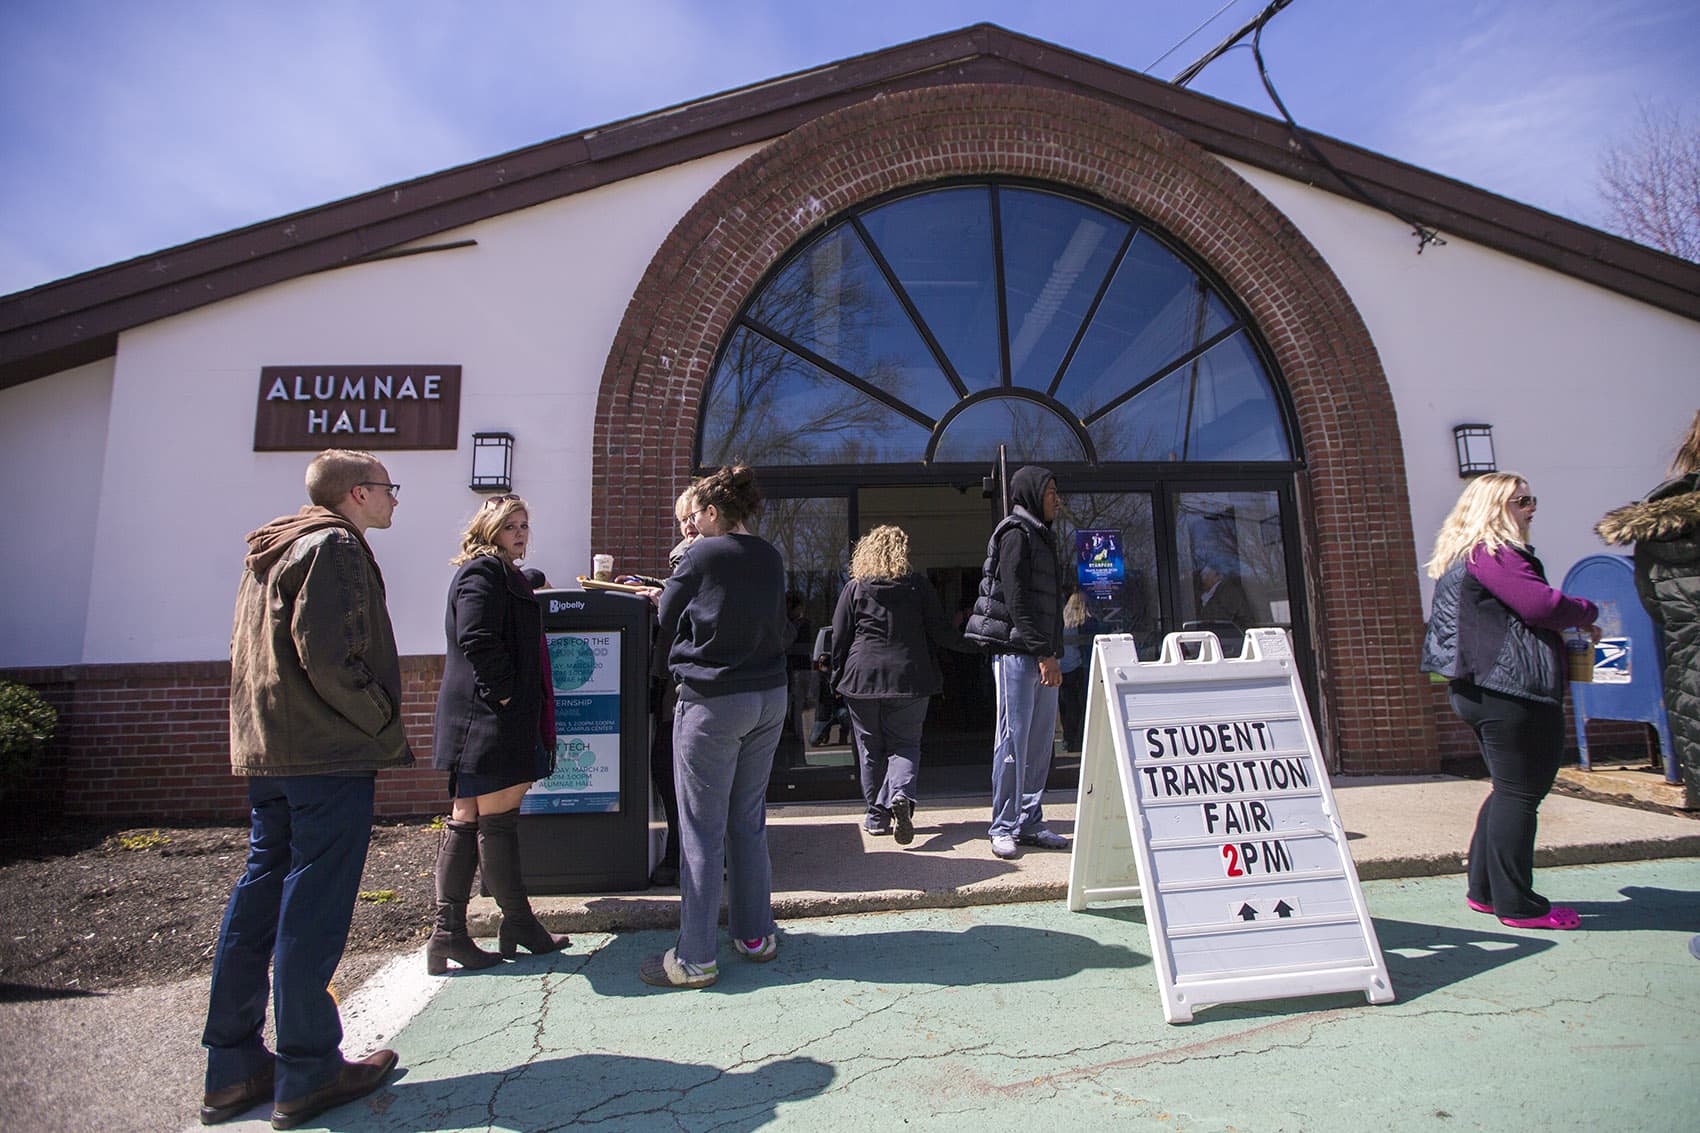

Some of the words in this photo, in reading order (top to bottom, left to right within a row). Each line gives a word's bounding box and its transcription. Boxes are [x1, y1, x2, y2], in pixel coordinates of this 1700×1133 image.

[266, 375, 441, 400] ALUMNAE
[308, 409, 396, 433] HALL
[549, 599, 585, 613] Bigbelly
[547, 638, 568, 647] EERS
[571, 638, 589, 646] FOR
[592, 637, 609, 645] THE
[555, 698, 593, 707] ERNSHIP
[564, 743, 590, 751] TECH
[1146, 722, 1267, 758] STUDENT
[1143, 758, 1308, 797] TRANSITION
[1203, 801, 1271, 834] FAIR
[1222, 839, 1290, 877] 2PM
